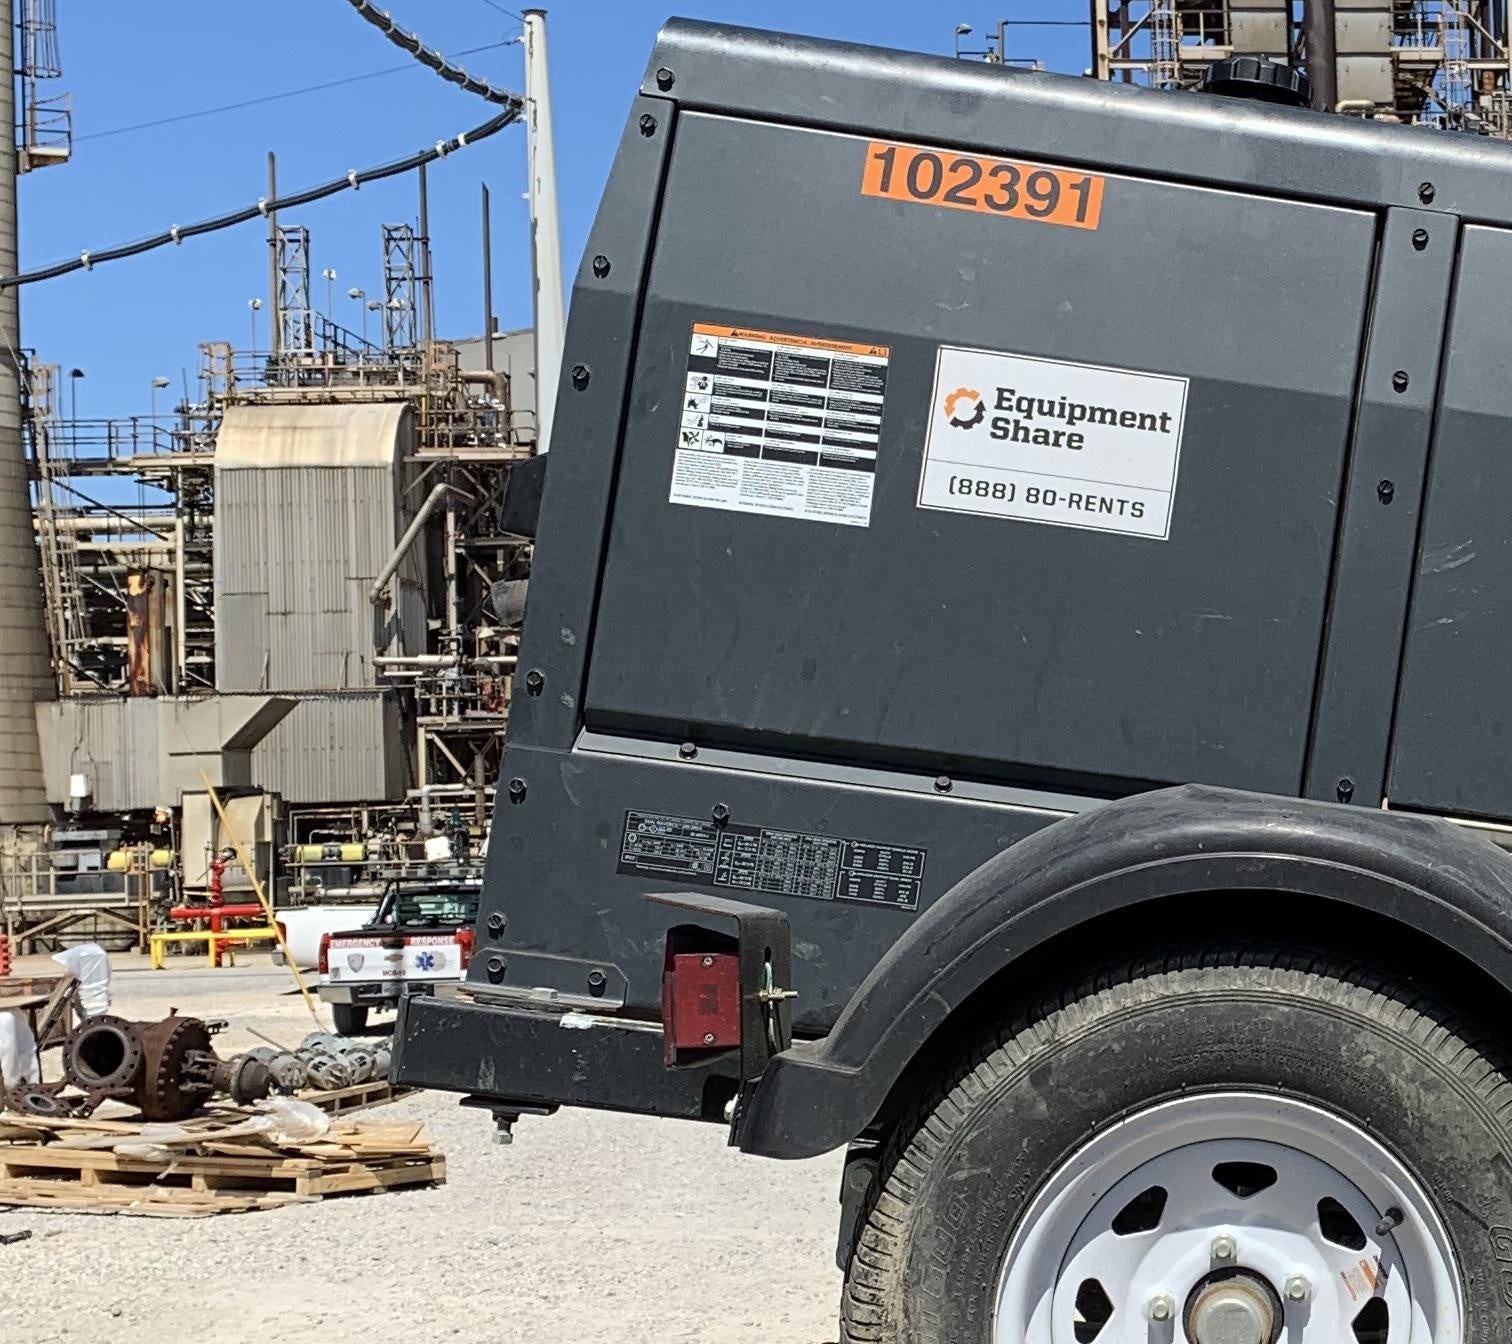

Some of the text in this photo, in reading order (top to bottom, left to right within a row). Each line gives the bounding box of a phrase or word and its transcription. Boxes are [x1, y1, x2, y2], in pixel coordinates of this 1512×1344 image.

[872, 146, 1095, 223] 102391
[995, 387, 1172, 434] Equipment
[991, 417, 1085, 450] Share
[948, 476, 1146, 520] (888) 80-RENTS
[330, 936, 456, 948] EMERGENCY RESPONSE
